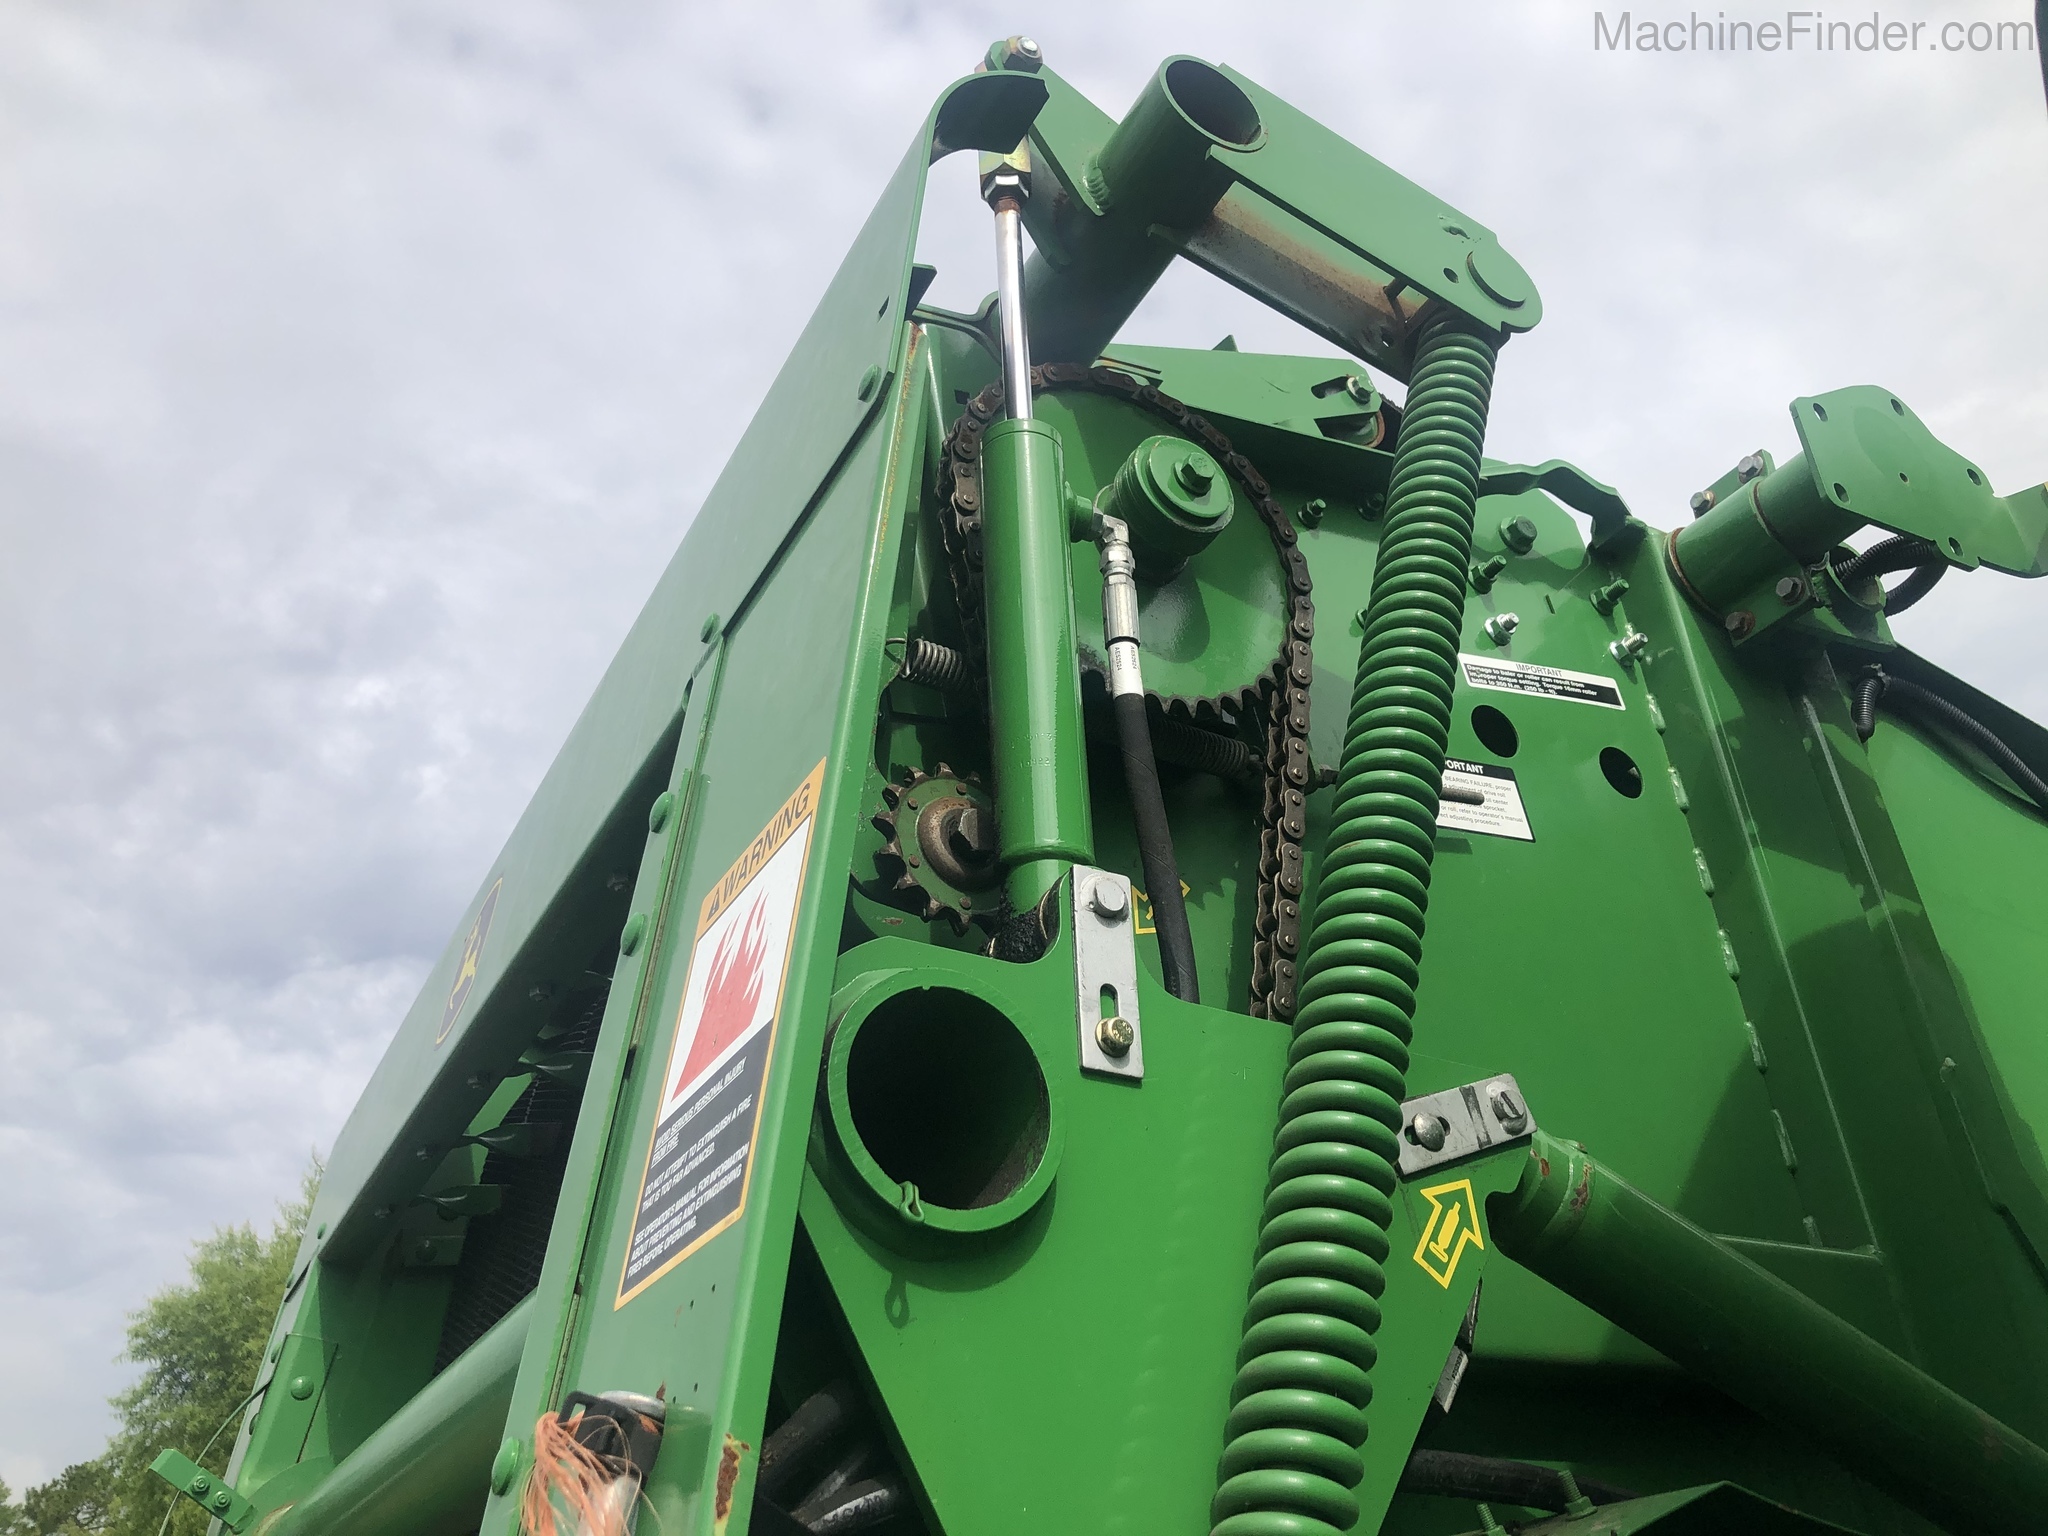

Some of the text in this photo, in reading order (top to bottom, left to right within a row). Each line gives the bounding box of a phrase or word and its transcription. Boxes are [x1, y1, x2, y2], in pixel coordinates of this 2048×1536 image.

[1467, 665, 1493, 674] Damage
[1515, 664, 1563, 677] IMPORTANT
[1542, 682, 1563, 691] Torque
[1445, 760, 1484, 774] ORTANT
[723, 782, 811, 903] WARNING
[655, 1056, 747, 1149] AVOID SERIOUS PERSONAL INJURY
[645, 1094, 752, 1197] DO NOT ATTEMPT TO EXTINGUISH A FIRE
[651, 1144, 667, 1165] FROM
[630, 1162, 743, 1262] ABOUT PREVENTING AND EXTINGUISHING
[634, 1229, 645, 1246] SEE
[674, 1185, 698, 1212] MANUAL
[697, 1174, 710, 1194] FOR
[709, 1141, 750, 1183] INFORMATION
[641, 1194, 655, 1213] THAT
[654, 1188, 661, 1202] IS
[660, 1178, 673, 1196] TOO
[672, 1168, 684, 1186] FAR
[627, 1258, 643, 1279] FIRES
[642, 1241, 664, 1267] BEFORE
[663, 1213, 698, 1250] OPERATING.
